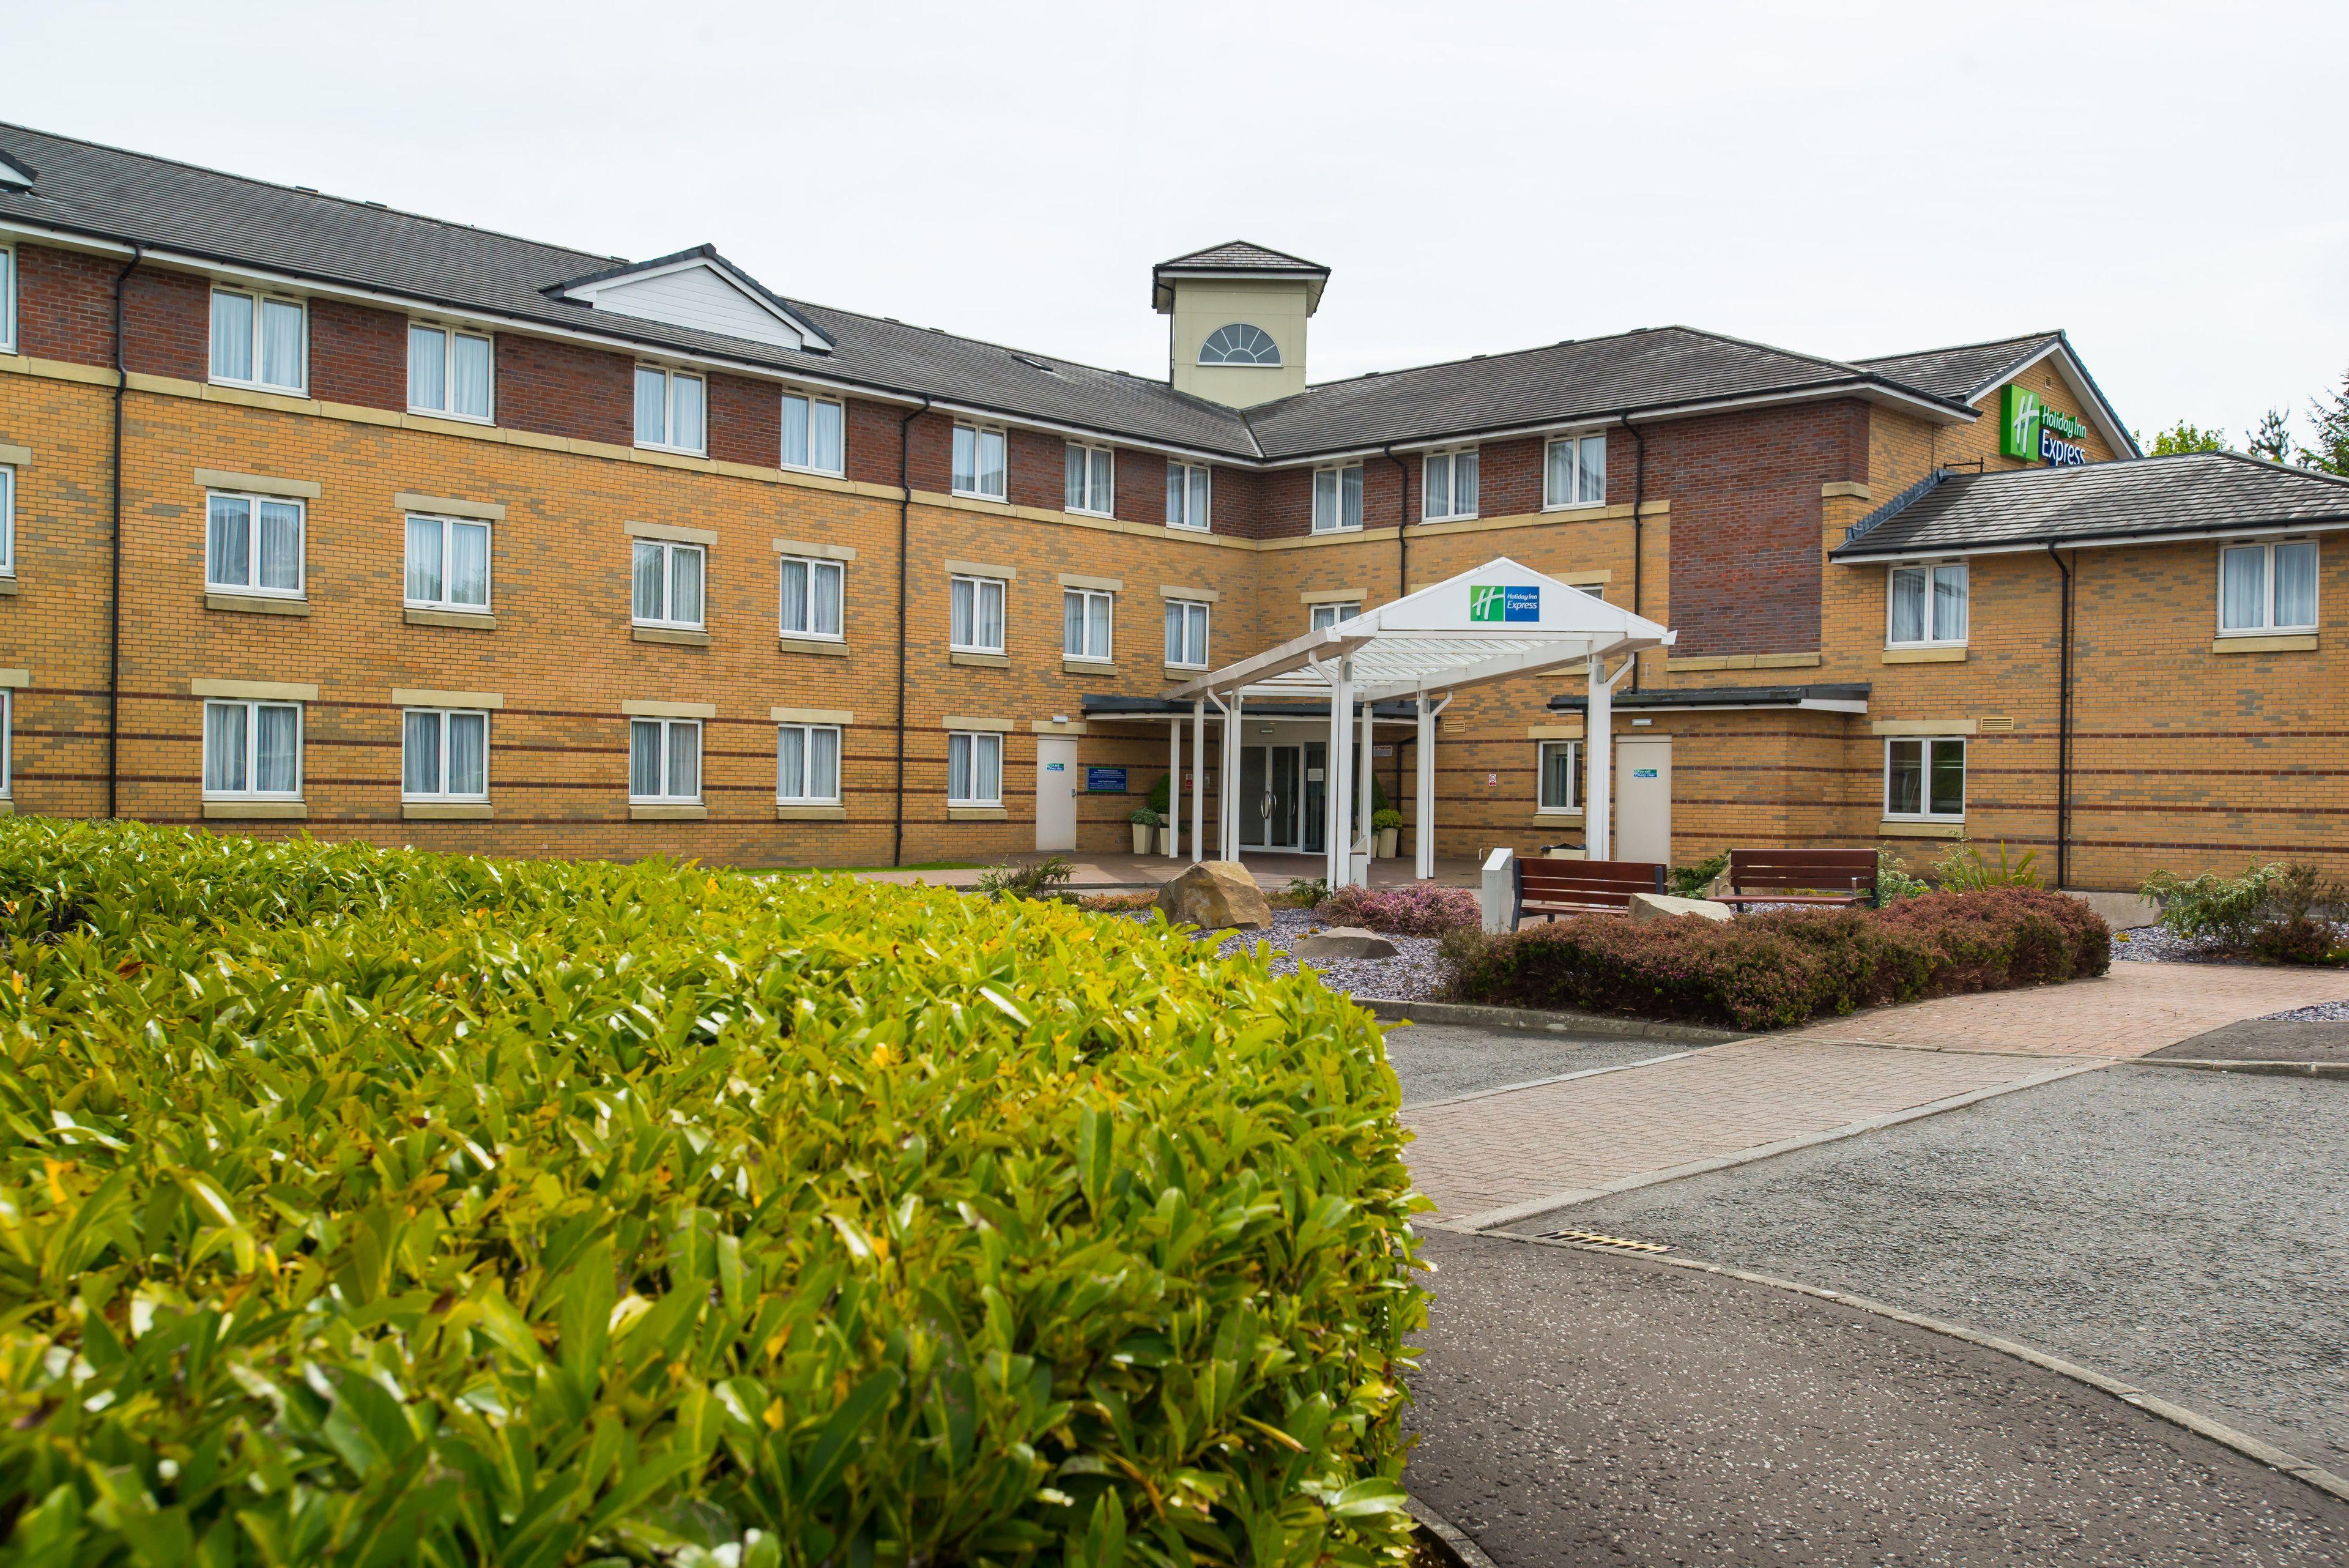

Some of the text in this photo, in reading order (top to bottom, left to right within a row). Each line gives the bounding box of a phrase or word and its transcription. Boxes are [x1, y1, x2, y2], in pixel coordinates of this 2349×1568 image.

[2043, 405, 2087, 439] Holiday Inn
[2042, 428, 2085, 466] Express
[1507, 600, 1537, 611] Express
